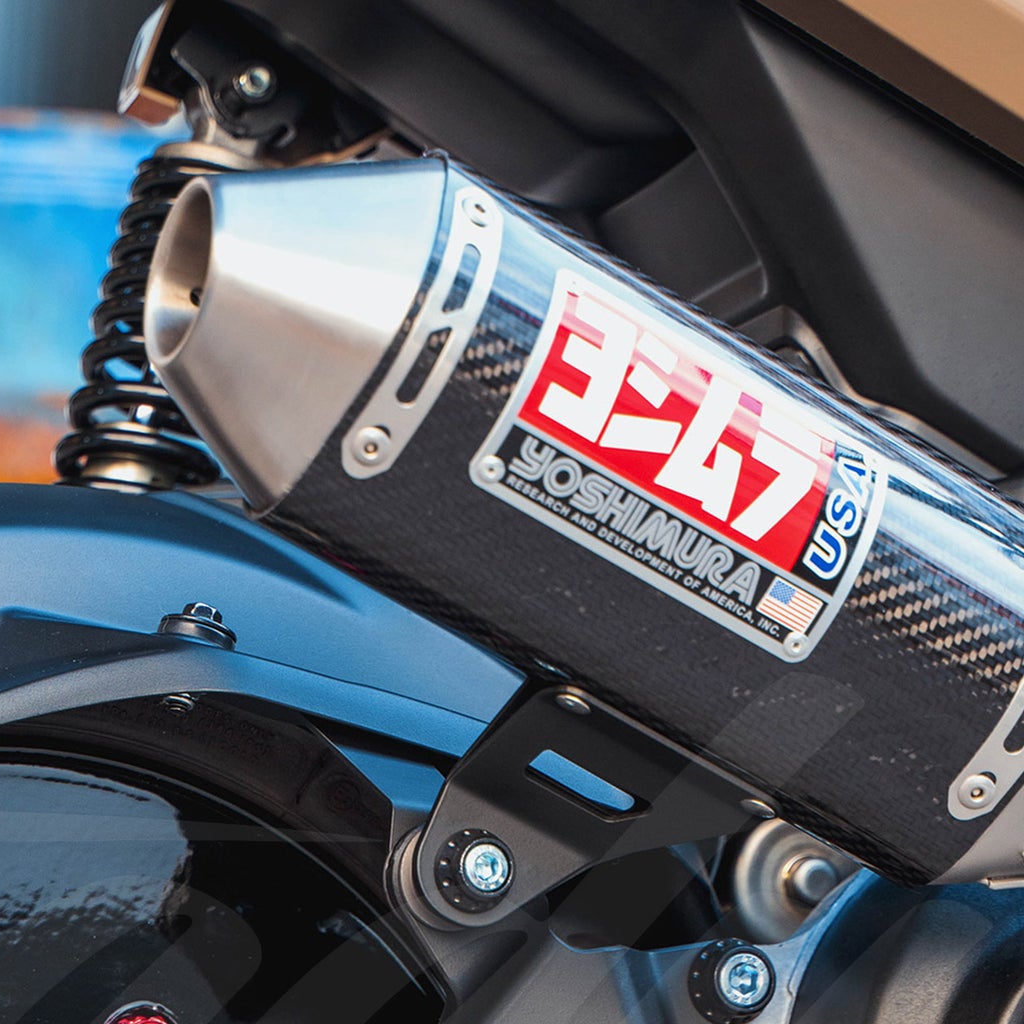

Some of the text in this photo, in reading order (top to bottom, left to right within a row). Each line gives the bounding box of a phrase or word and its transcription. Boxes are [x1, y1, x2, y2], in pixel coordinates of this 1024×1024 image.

[506, 476, 781, 638] RESEARCH AND DEVELOPMENT OF AMERICA, INC.
[508, 435, 762, 606] YOSHIMURA
[802, 456, 874, 581] USA
